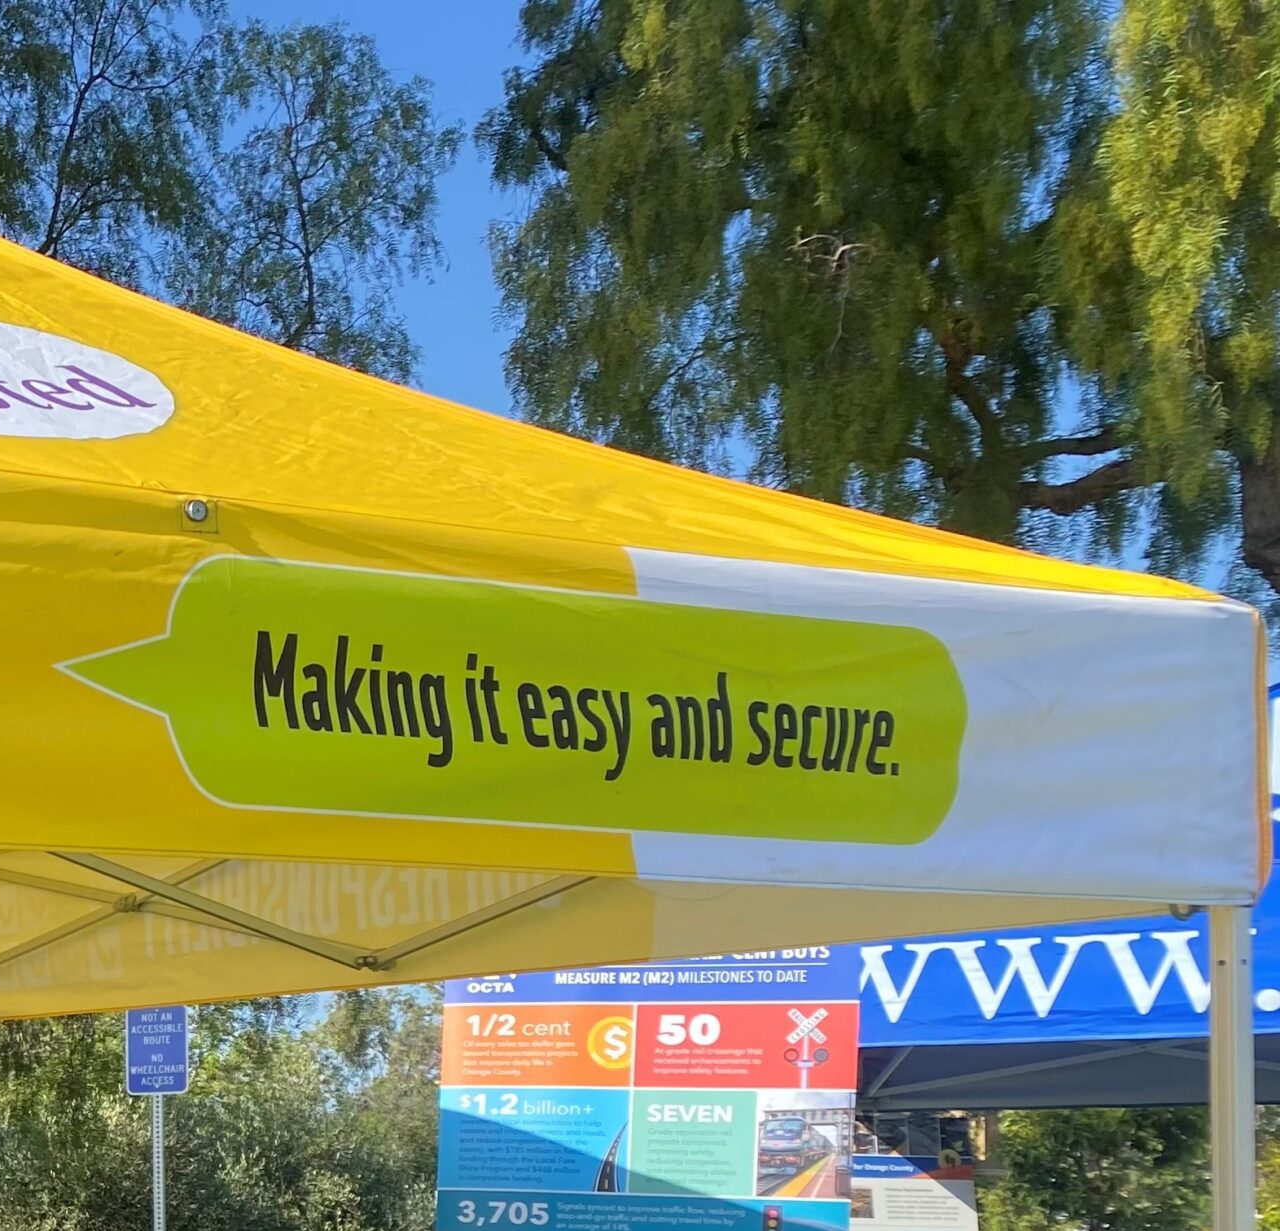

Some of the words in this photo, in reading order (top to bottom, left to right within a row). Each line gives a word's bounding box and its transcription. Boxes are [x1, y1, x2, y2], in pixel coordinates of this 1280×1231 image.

[254, 630, 456, 767] Making
[466, 653, 508, 745] it
[519, 679, 631, 781] easy
[650, 671, 733, 763] and
[747, 698, 901, 777] secure.
[782, 945, 830, 959] BUYS
[555, 971, 616, 986] MEASURE
[620, 971, 640, 985] M2
[643, 970, 675, 986] (M2)
[677, 970, 754, 985] MILESTONES
[757, 970, 773, 983] TO
[776, 970, 808, 983] DATE
[467, 983, 514, 993] OCTA
[141, 1013, 158, 1023] NOT
[160, 1012, 173, 1021] AN
[131, 1023, 183, 1034] ACCESSIBLE
[466, 1013, 516, 1037] 1/2
[521, 1021, 571, 1036] cent
[656, 1013, 721, 1046] 50
[143, 1035, 171, 1045] ROUTE
[151, 1053, 163, 1063] NO
[130, 1064, 185, 1075] WHEELCHAIR
[141, 1076, 174, 1086] ACCESS
[460, 1093, 518, 1116] $1.2
[524, 1101, 594, 1116] billion+
[647, 1104, 733, 1122] SEVEN
[865, 1164, 889, 1174] Orange
[890, 1165, 915, 1174] County
[457, 1201, 549, 1225] 3,705
